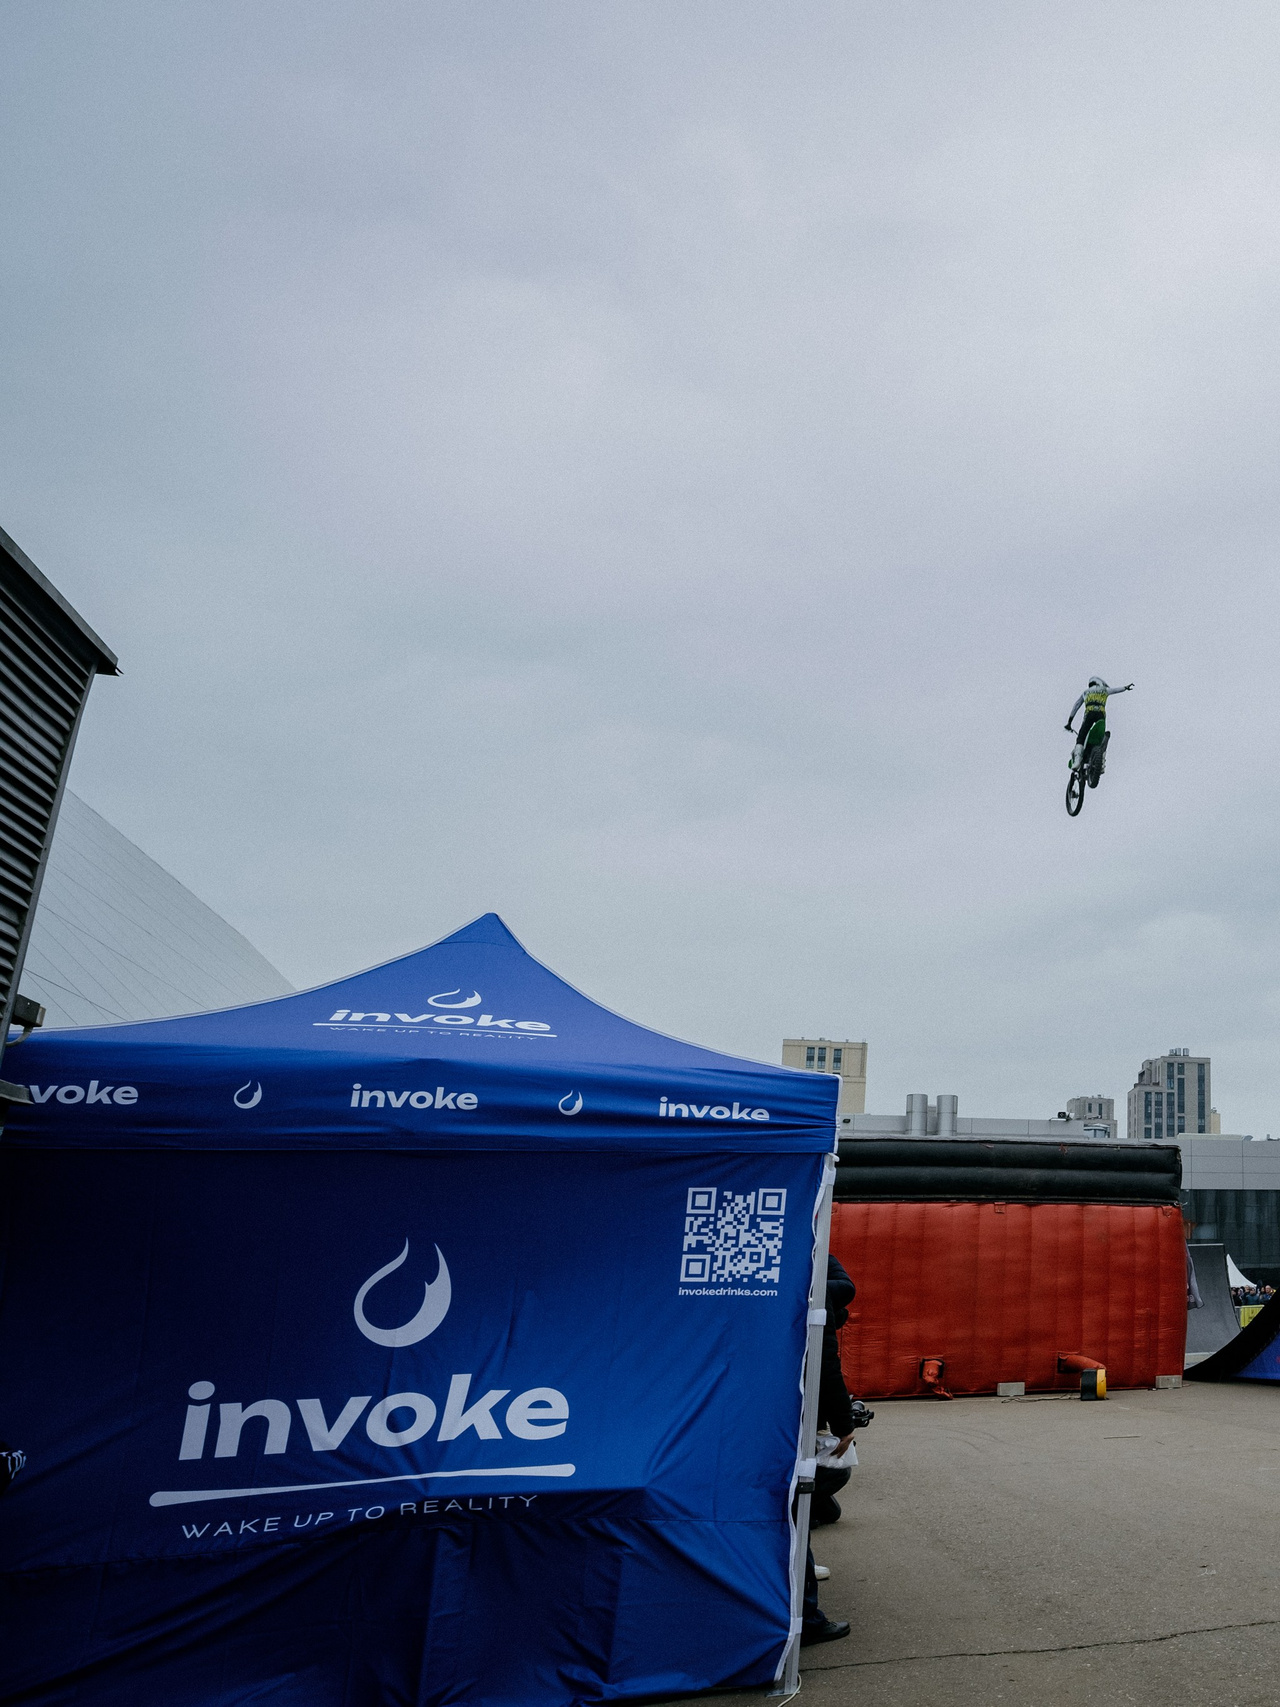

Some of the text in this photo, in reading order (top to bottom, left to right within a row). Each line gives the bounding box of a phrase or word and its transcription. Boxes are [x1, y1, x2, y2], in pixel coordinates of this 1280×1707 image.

[329, 1009, 551, 1031] invoke
[28, 1080, 139, 1105] voke
[350, 1083, 479, 1111] invoke
[659, 1096, 770, 1121] invoke
[678, 1286, 778, 1297] invokedrinks.com
[178, 1373, 570, 1461] invoke
[182, 1494, 539, 1539] WAKE UP TO REALITY
